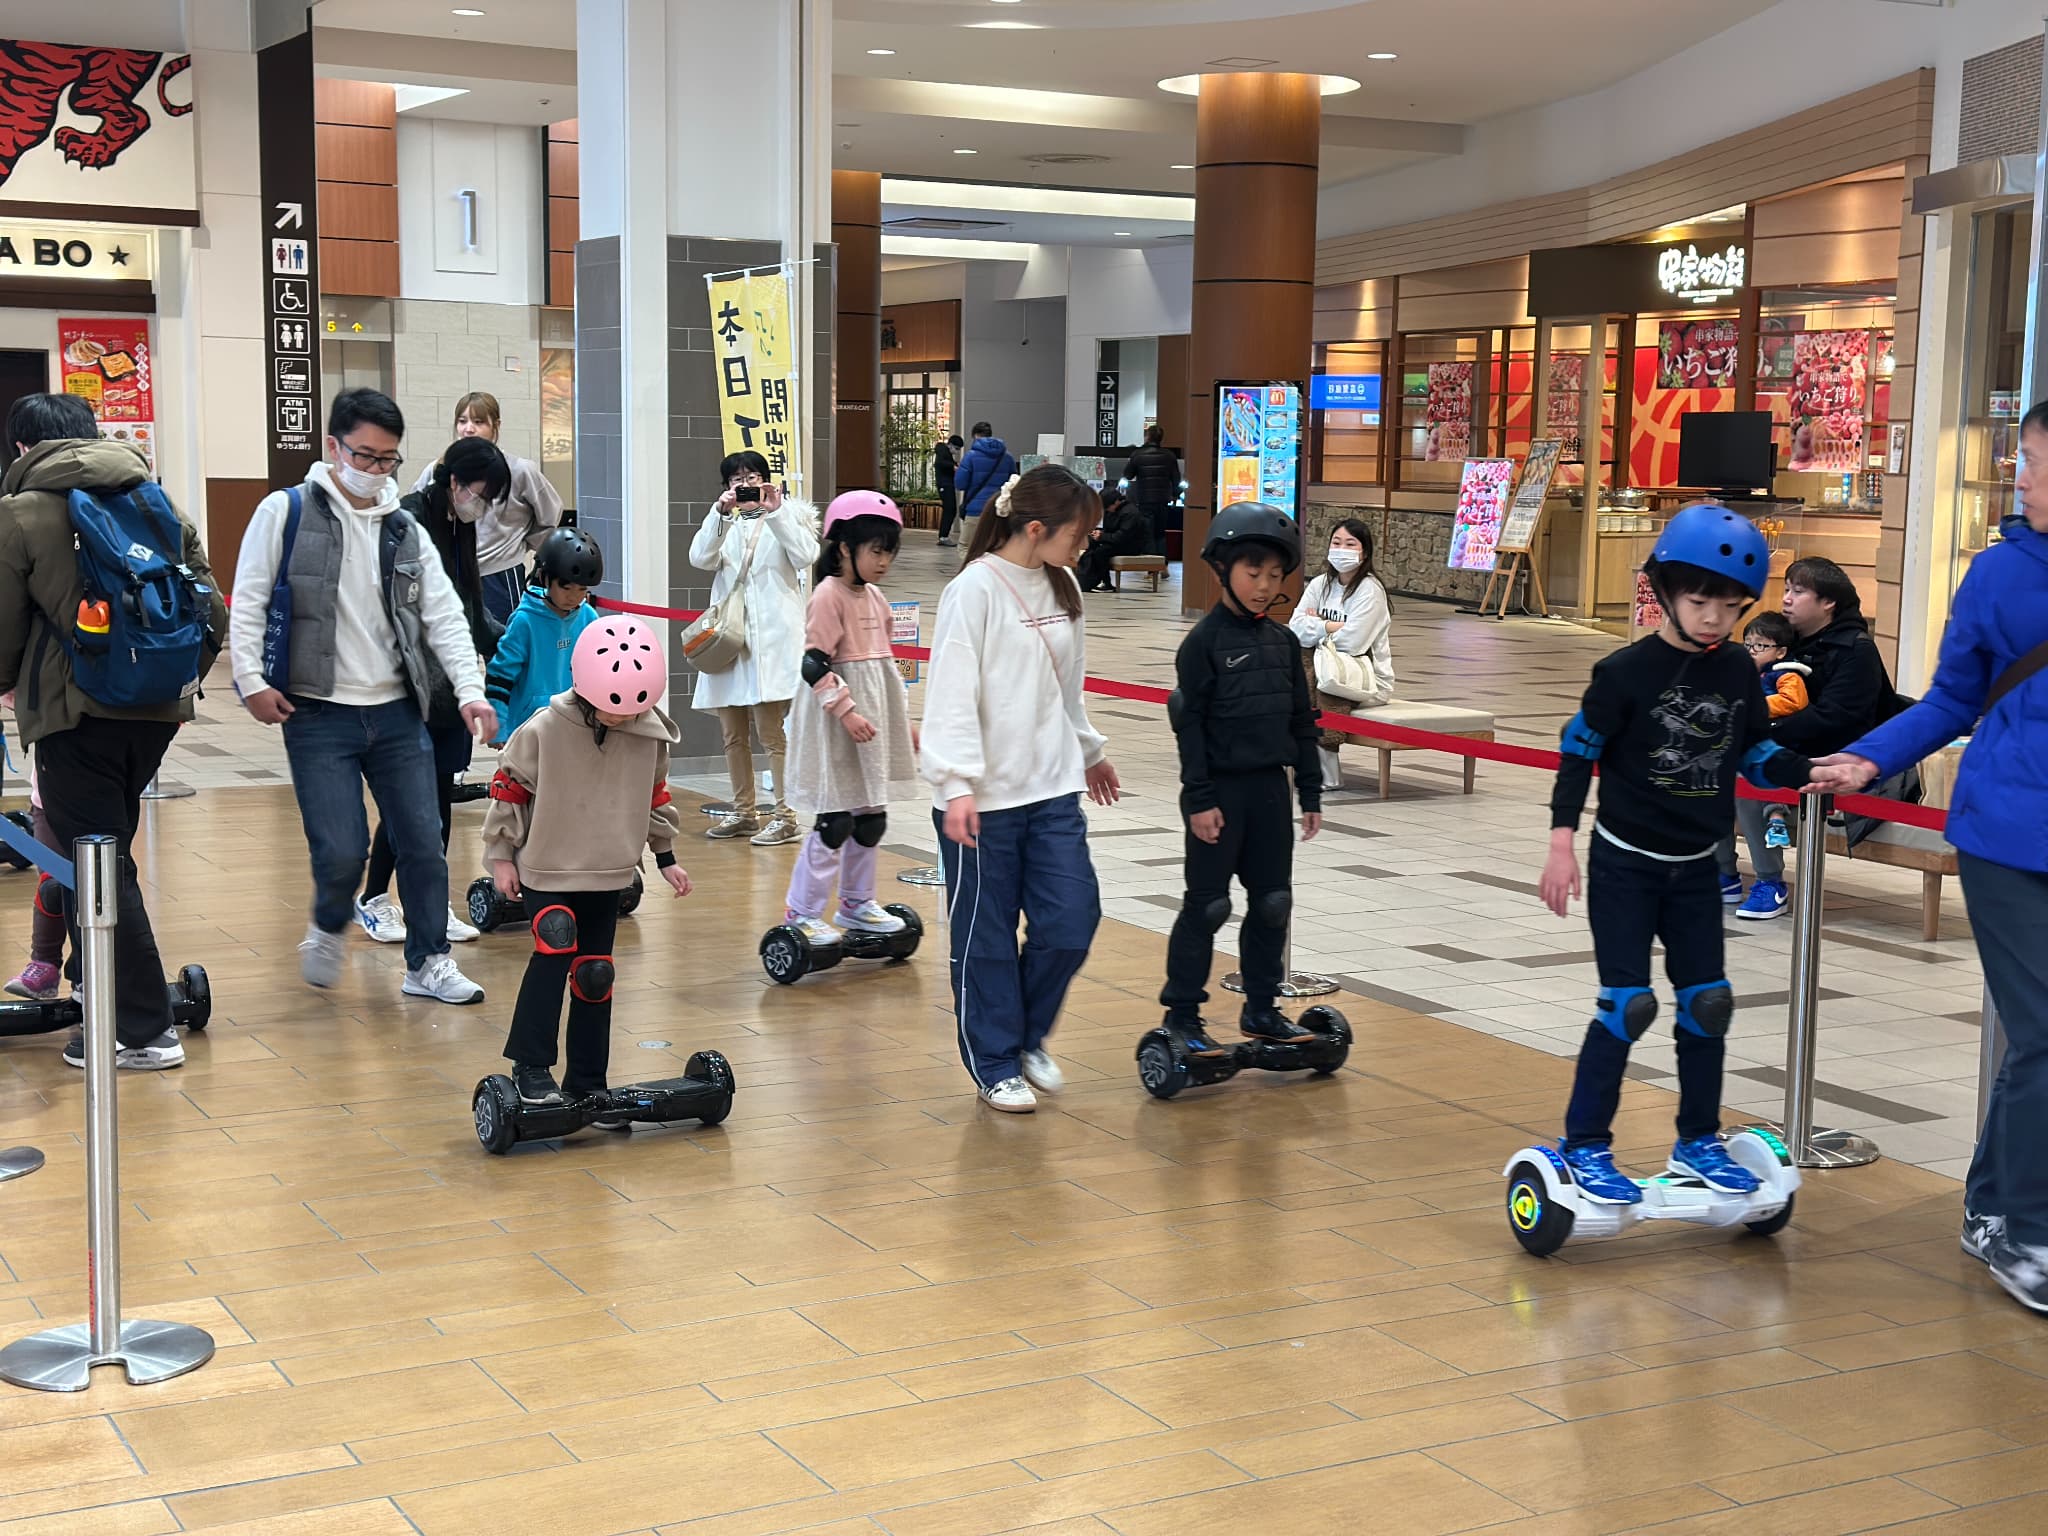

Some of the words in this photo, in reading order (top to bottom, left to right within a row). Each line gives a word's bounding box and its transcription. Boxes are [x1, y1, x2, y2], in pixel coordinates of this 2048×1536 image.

[460, 189, 477, 246] 1
[32, 238, 92, 268] BO
[326, 320, 337, 332] 5
[284, 399, 304, 407] ATM
[1799, 385, 1858, 404] いちご狩り
